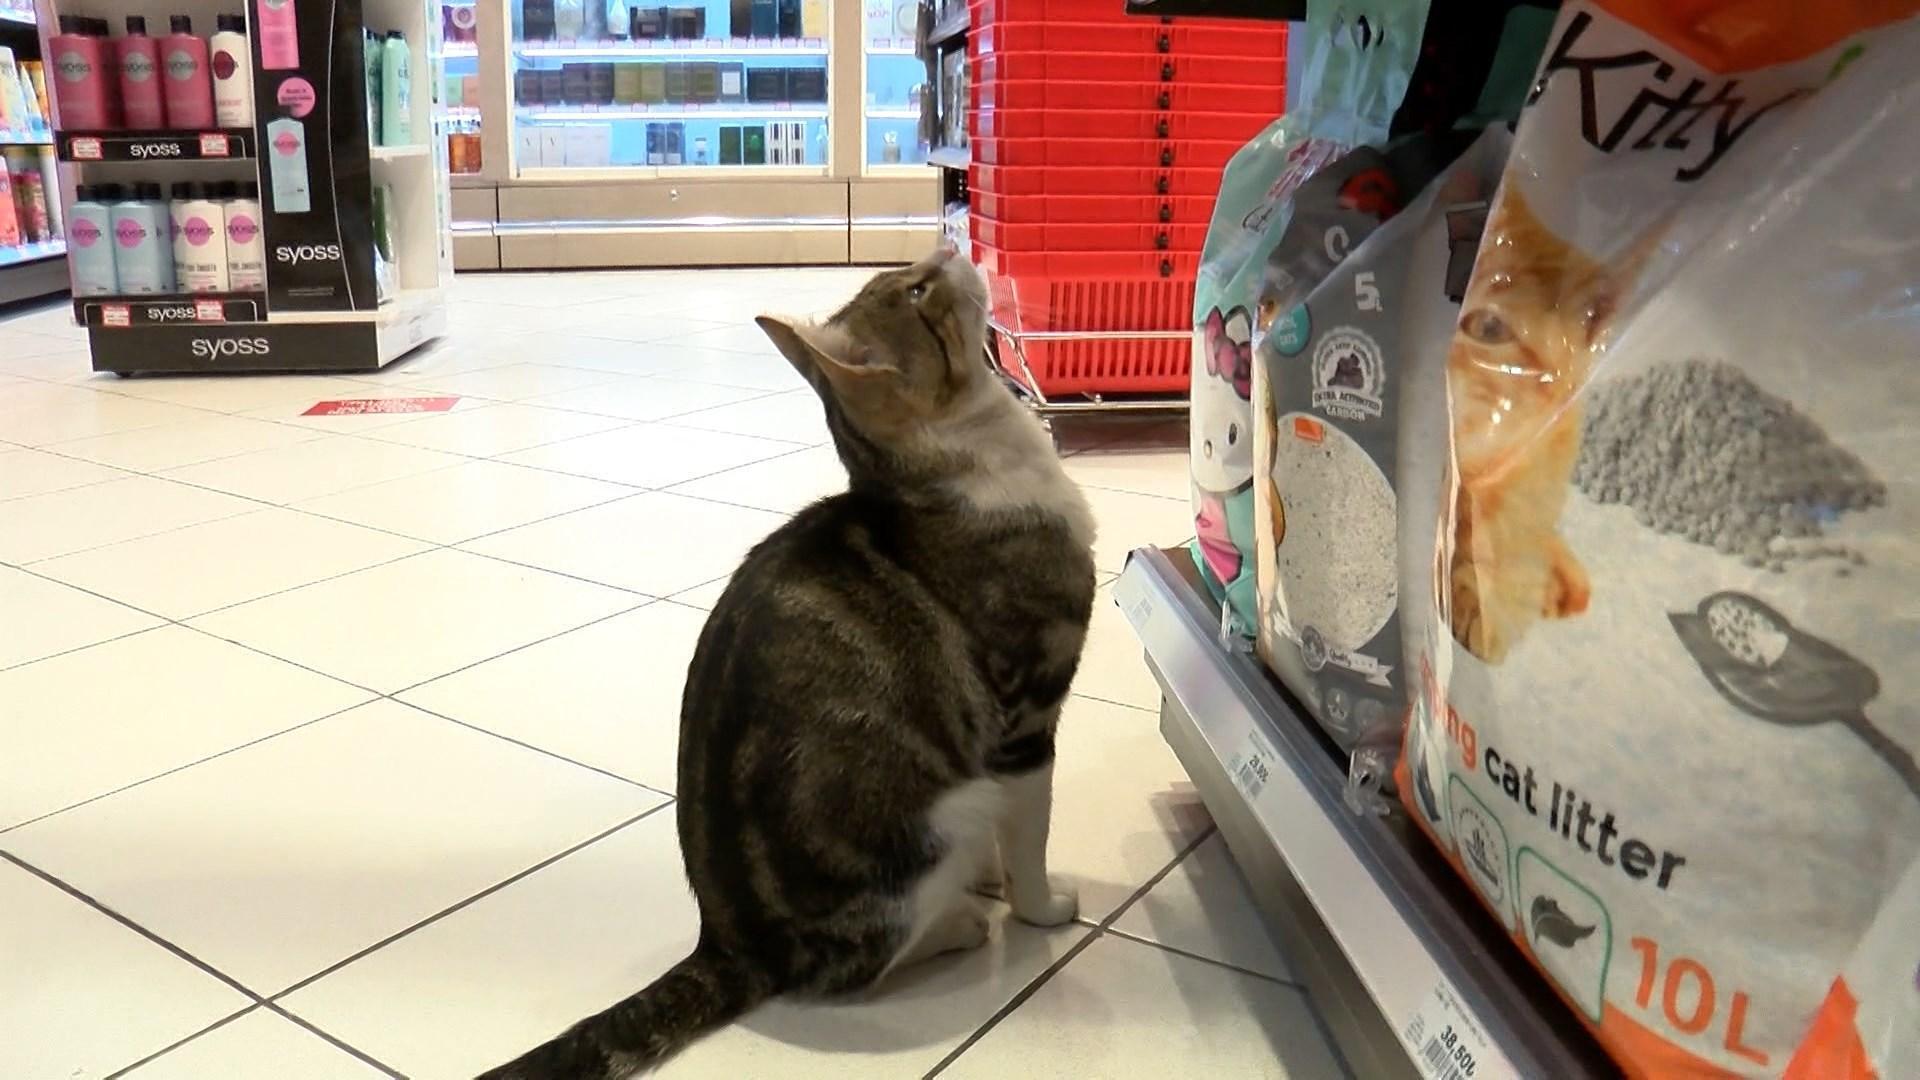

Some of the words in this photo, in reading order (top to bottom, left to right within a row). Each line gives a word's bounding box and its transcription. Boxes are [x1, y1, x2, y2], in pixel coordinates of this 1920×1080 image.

[1527, 10, 1822, 182] Kitty
[130, 143, 181, 159] syoss
[276, 244, 341, 266] syoss
[148, 307, 196, 322] syoss
[192, 337, 270, 361] syoss
[1484, 747, 1538, 817] cat
[1549, 781, 1687, 891] litter
